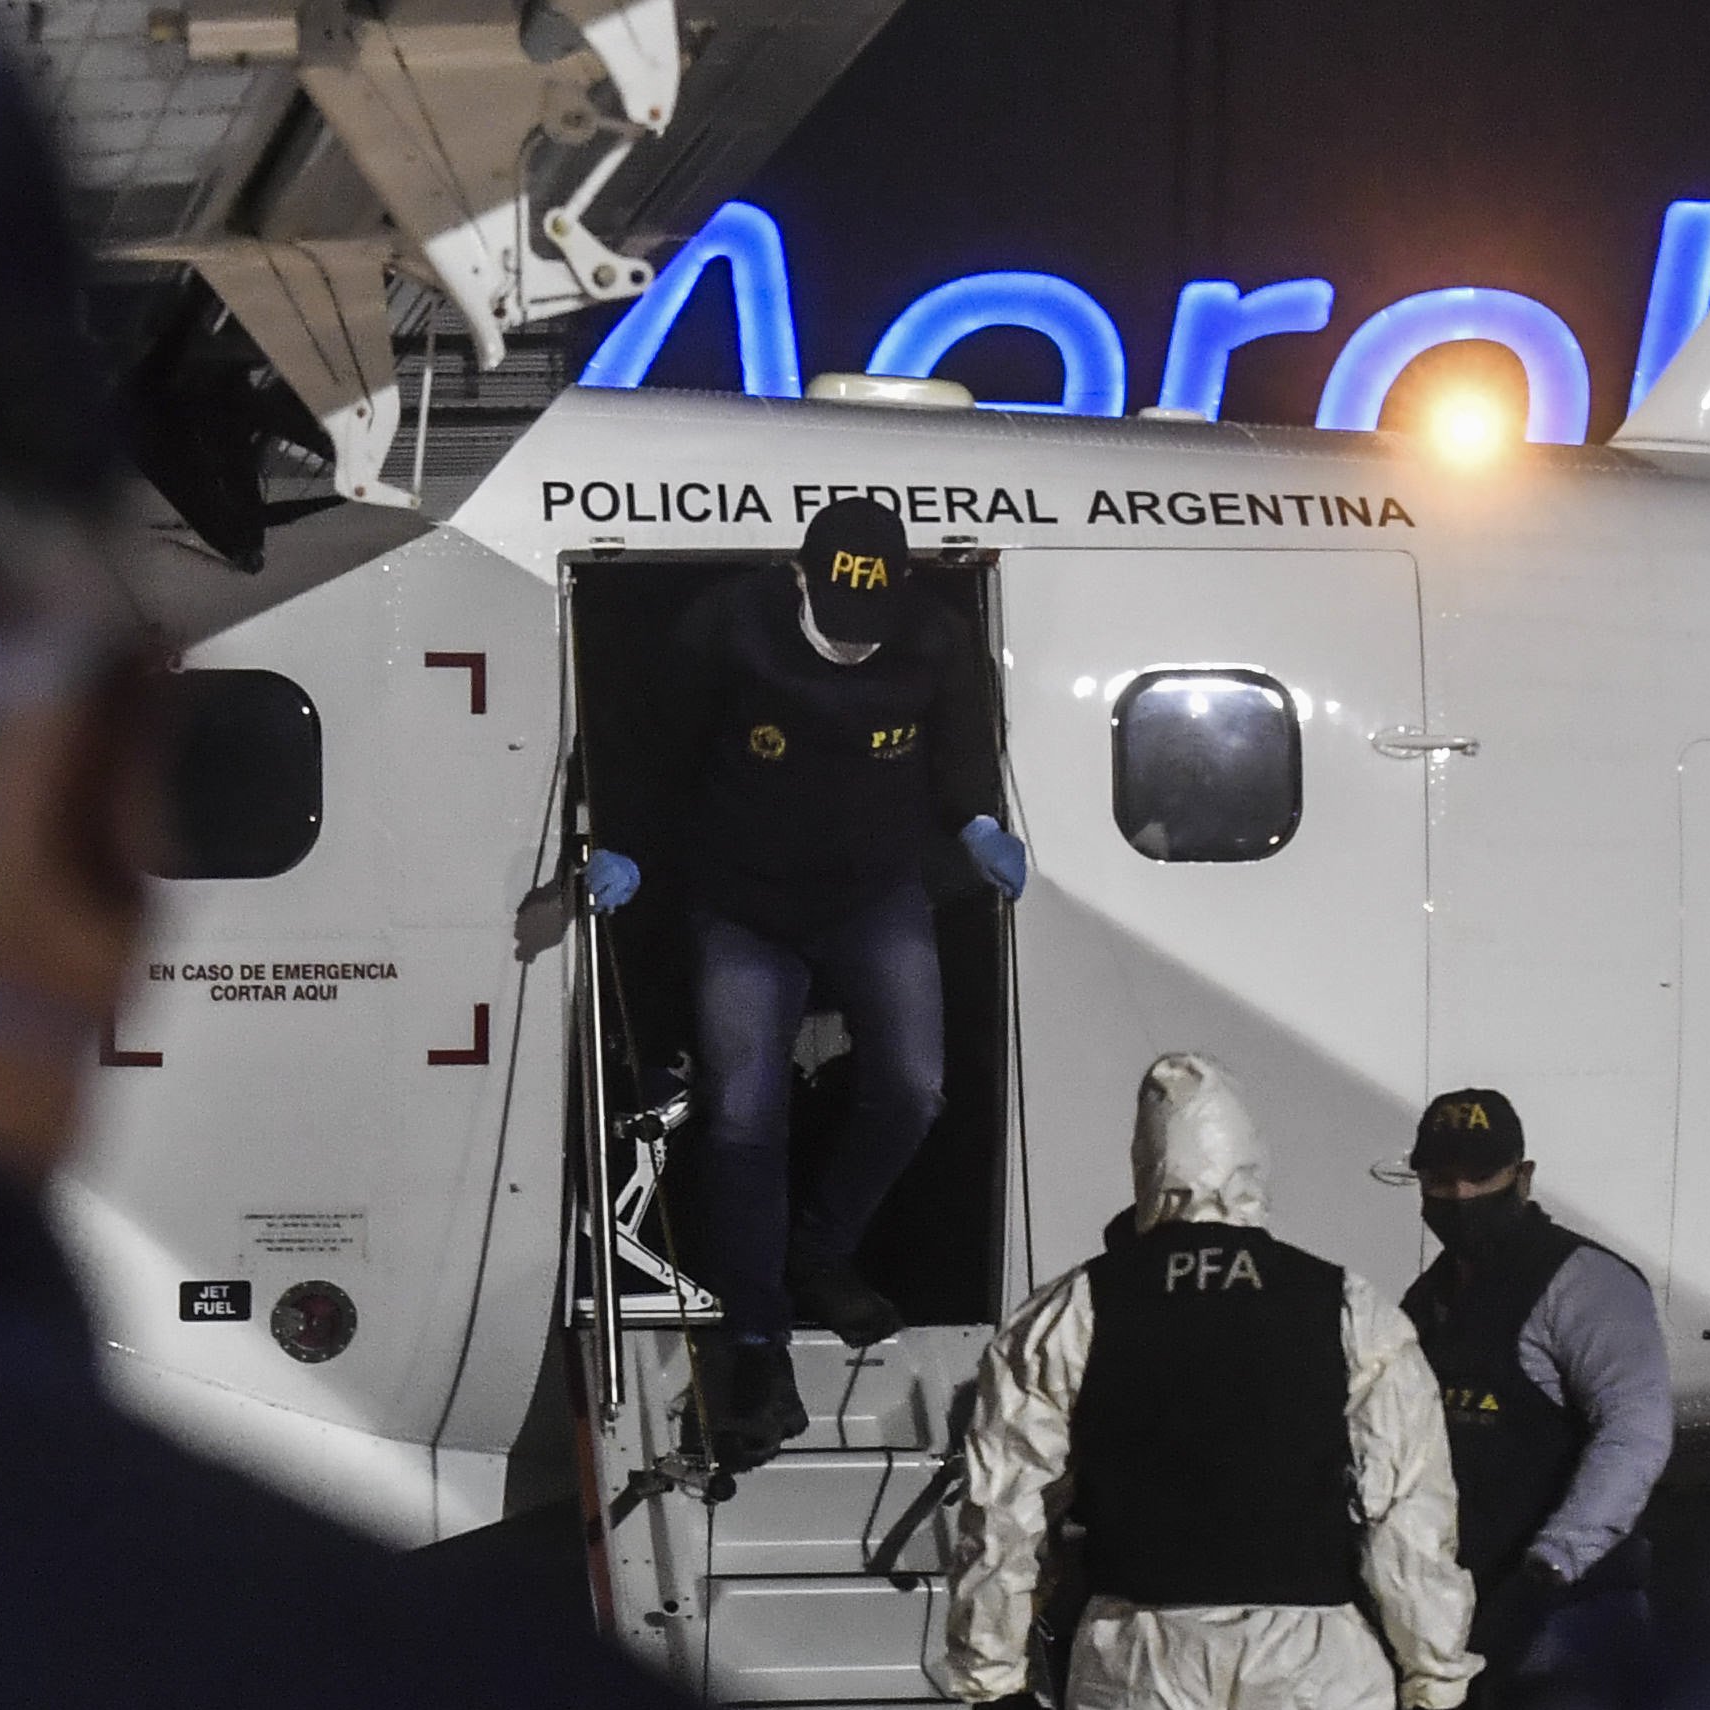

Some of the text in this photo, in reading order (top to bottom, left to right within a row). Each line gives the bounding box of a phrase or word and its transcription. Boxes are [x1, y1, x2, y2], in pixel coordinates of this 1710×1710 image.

[542, 480, 773, 523] POLICIA
[1086, 488, 1417, 529] ARGENTINA
[830, 549, 889, 590] PFA
[148, 962, 399, 982] EN CASO DE EMERGENCIA
[209, 983, 339, 1002] CORTAR AQUI
[1165, 1247, 1263, 1293] PFA
[198, 1284, 231, 1300] JET
[192, 1300, 237, 1316] FUEL
